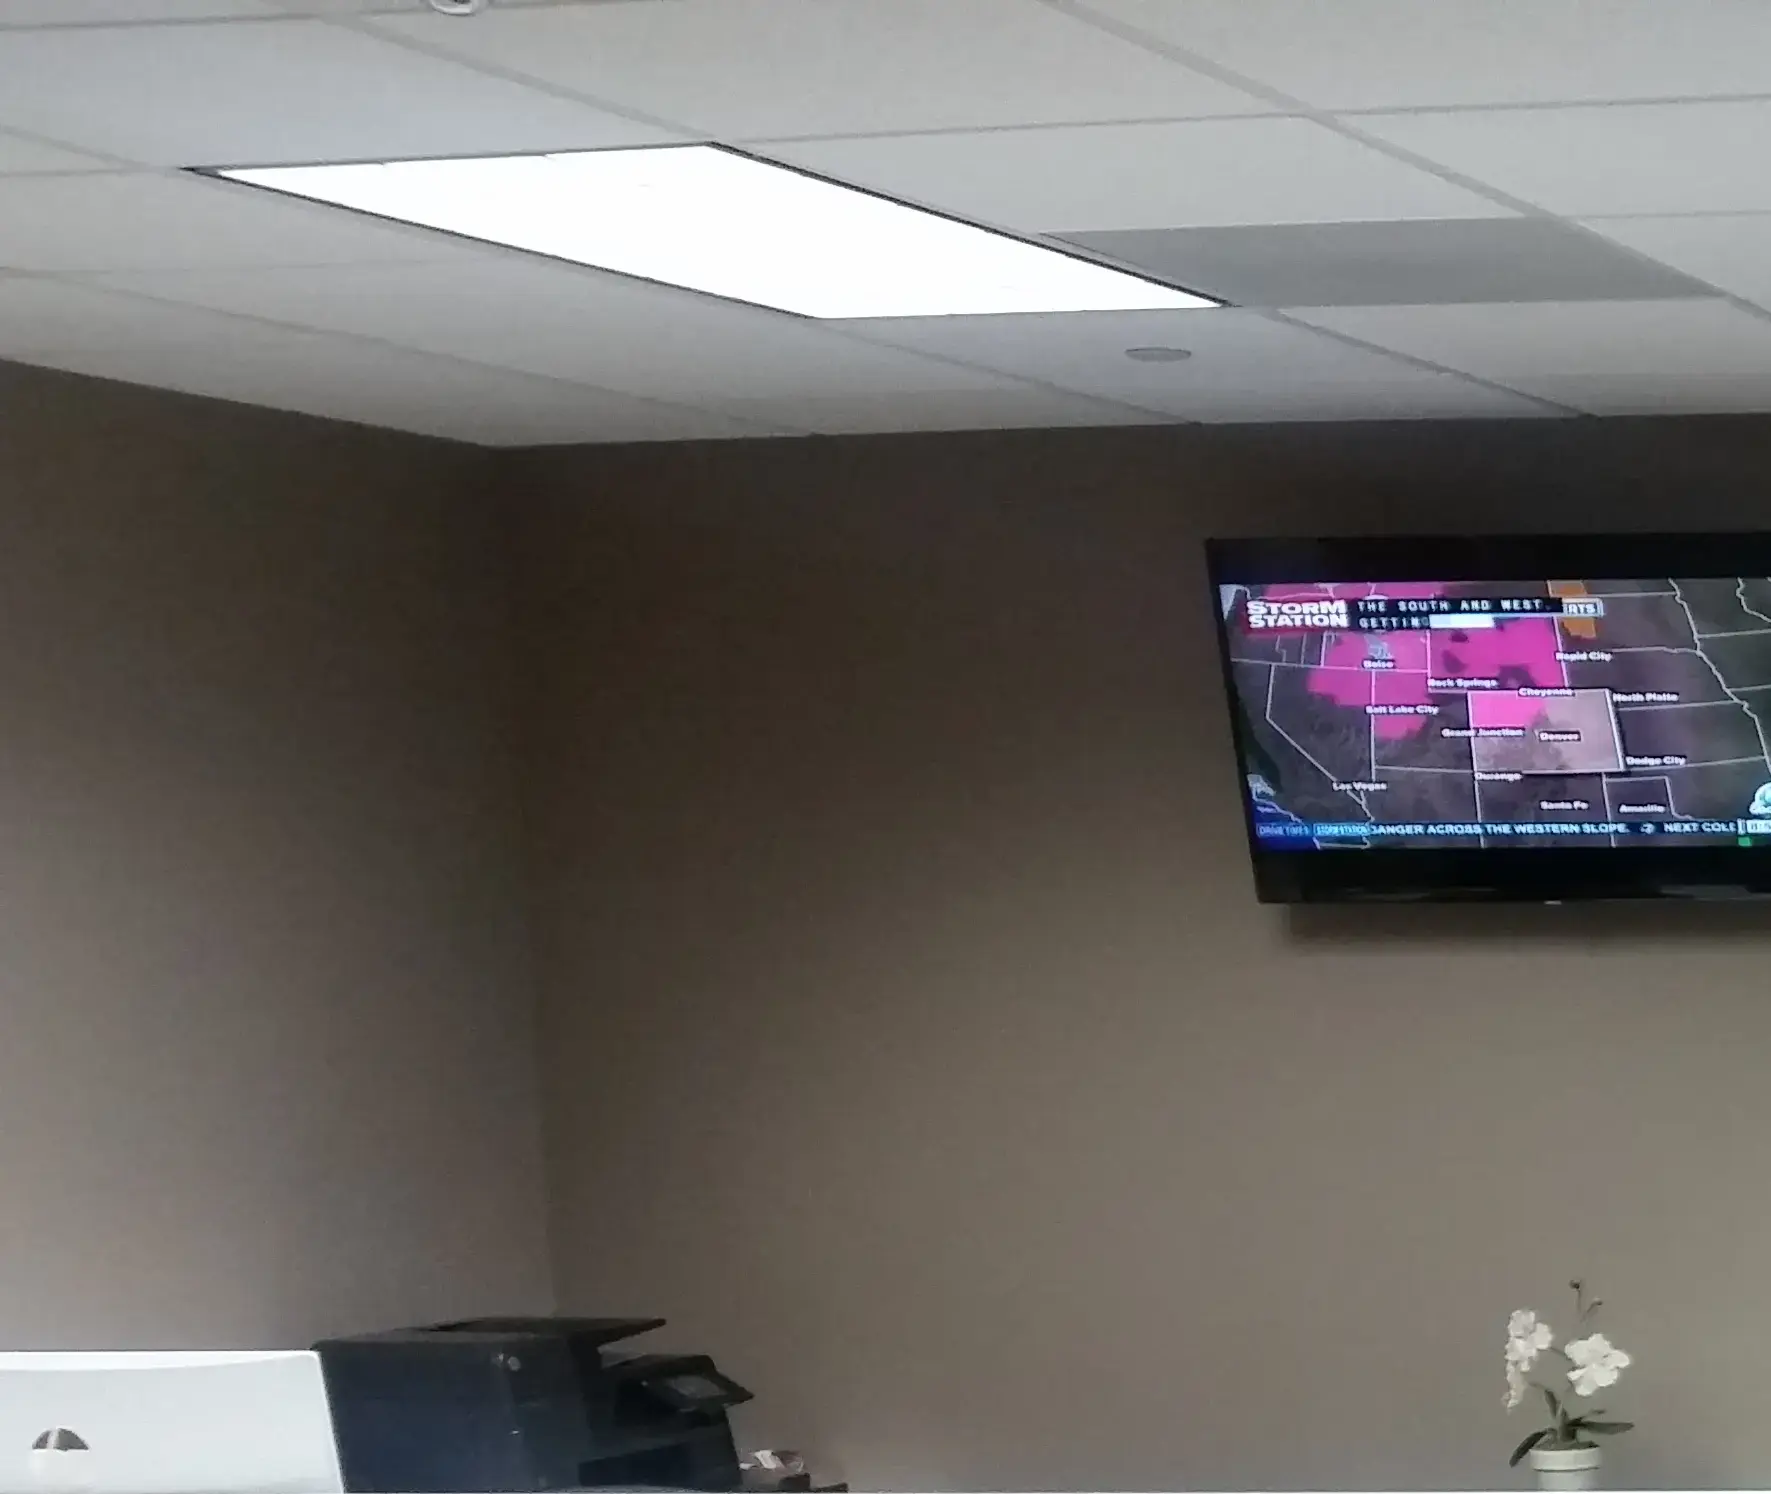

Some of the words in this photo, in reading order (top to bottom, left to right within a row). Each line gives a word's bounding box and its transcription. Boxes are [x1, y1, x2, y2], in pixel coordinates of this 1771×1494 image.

[1247, 600, 1347, 614] STORM
[1357, 601, 1387, 612] THE
[1397, 600, 1449, 612] SOUTH
[1460, 599, 1493, 611] AND
[1248, 614, 1349, 628] STATION
[1589, 651, 1612, 662] City
[1416, 705, 1439, 715] City
[1663, 755, 1687, 766] City
[1427, 825, 1482, 835] ACROSS
[1486, 824, 1512, 834] THE
[1514, 824, 1581, 834] WESTERN
[1664, 822, 1699, 833] NEXT
